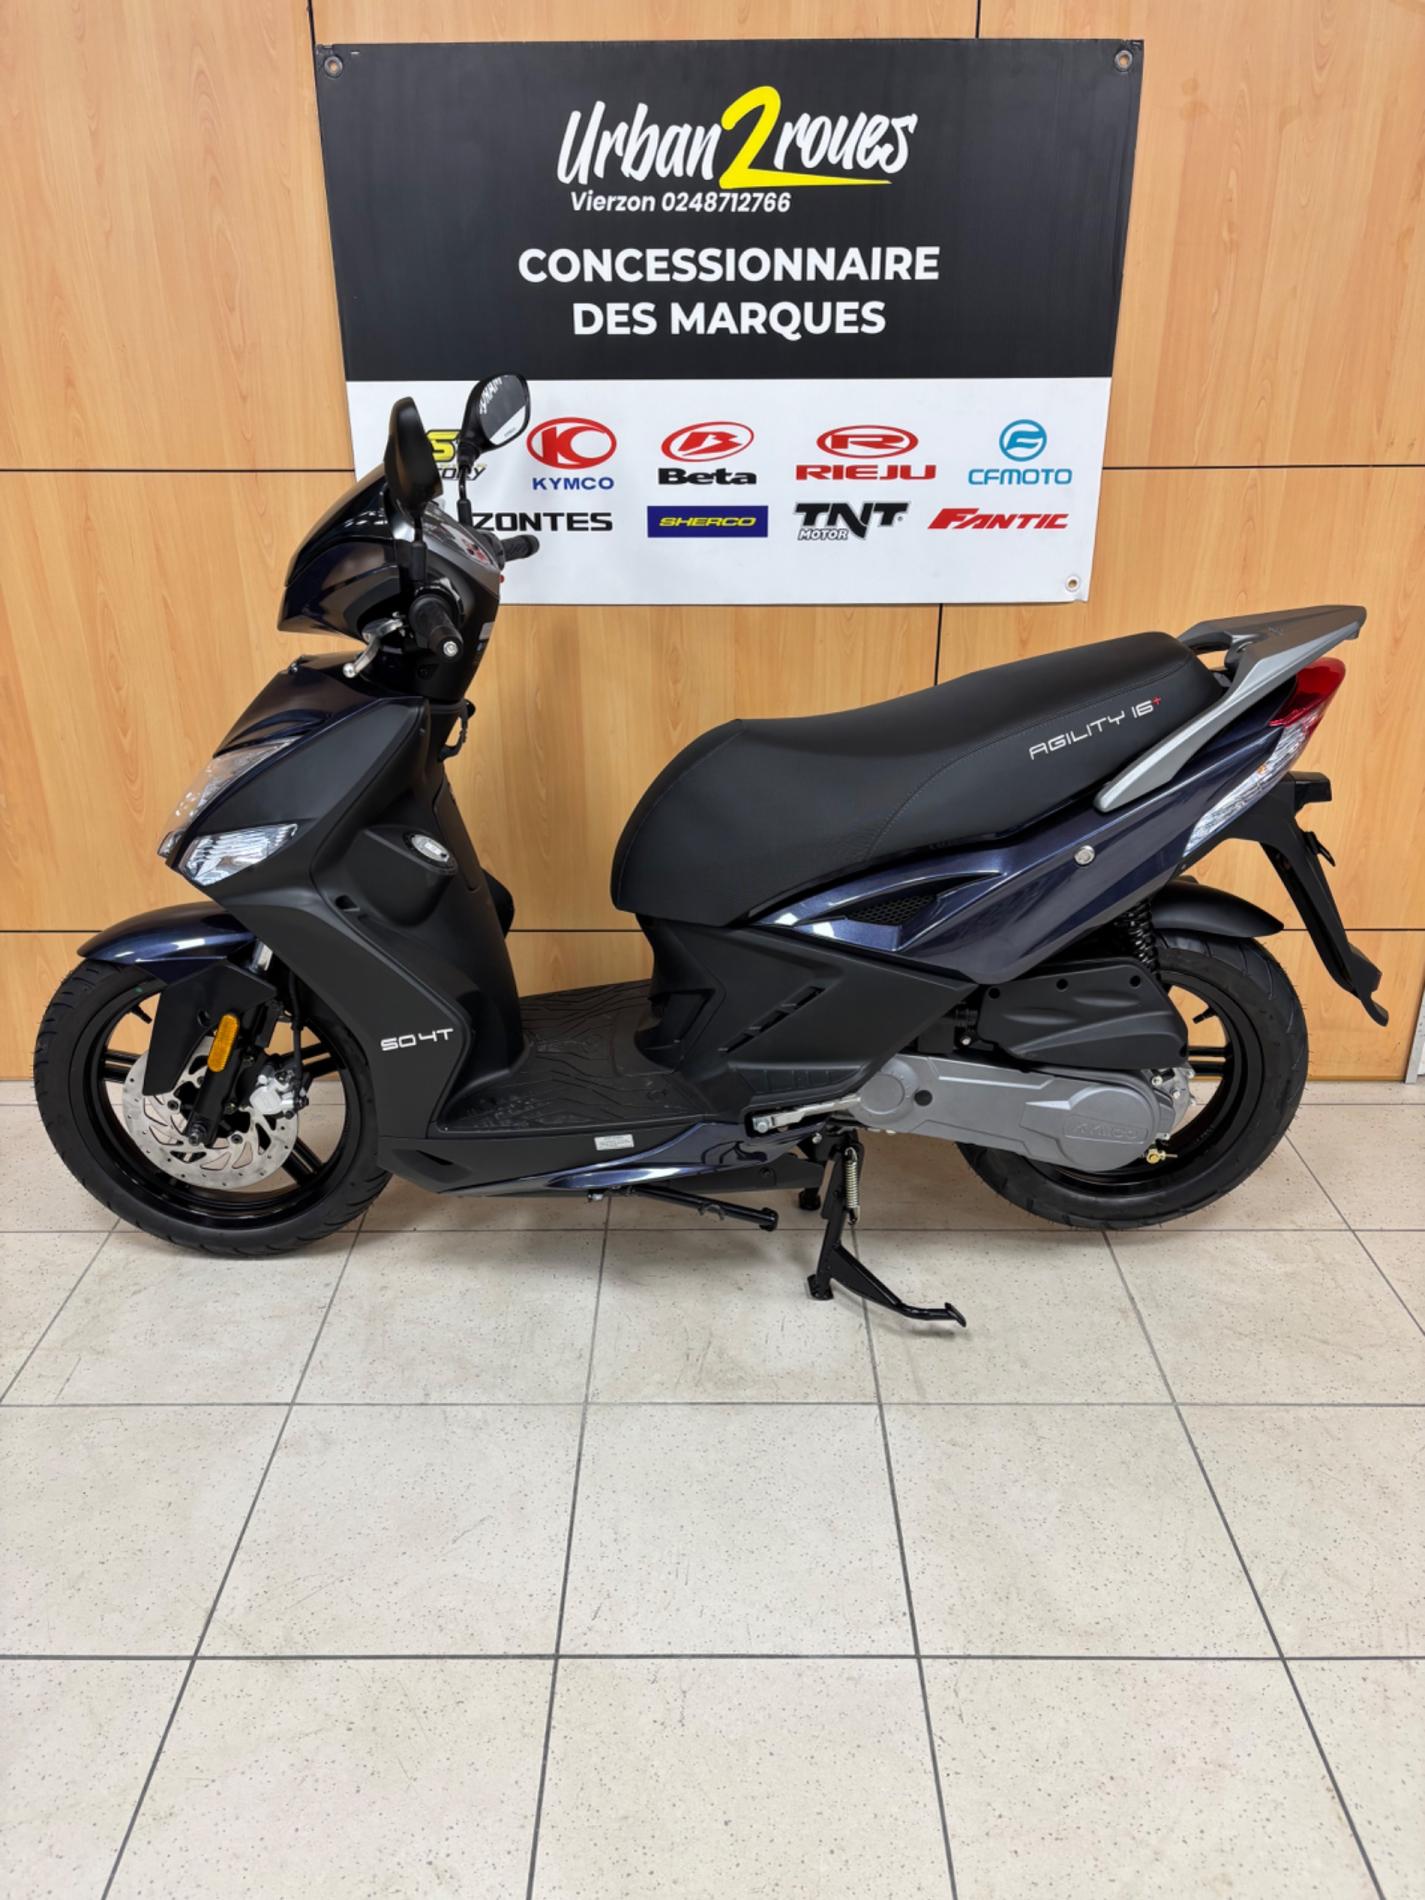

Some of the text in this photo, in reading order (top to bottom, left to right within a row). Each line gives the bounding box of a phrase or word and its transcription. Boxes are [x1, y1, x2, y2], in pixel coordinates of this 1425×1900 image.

[571, 191, 792, 212] Vierzon 0248712766
[518, 246, 940, 283] CONCESSIONNAIRE
[573, 300, 886, 341] DES MARQUES
[658, 467, 757, 485] Beta
[796, 464, 936, 480] RIEJU
[968, 468, 1072, 485] CFMOTO
[532, 477, 615, 490] KYMCO
[472, 512, 613, 531] ZONTES
[659, 517, 756, 527] SHERCO
[795, 502, 909, 539] TNT
[798, 528, 848, 541] MOTOR
[1029, 710, 1125, 760] AGILITY
